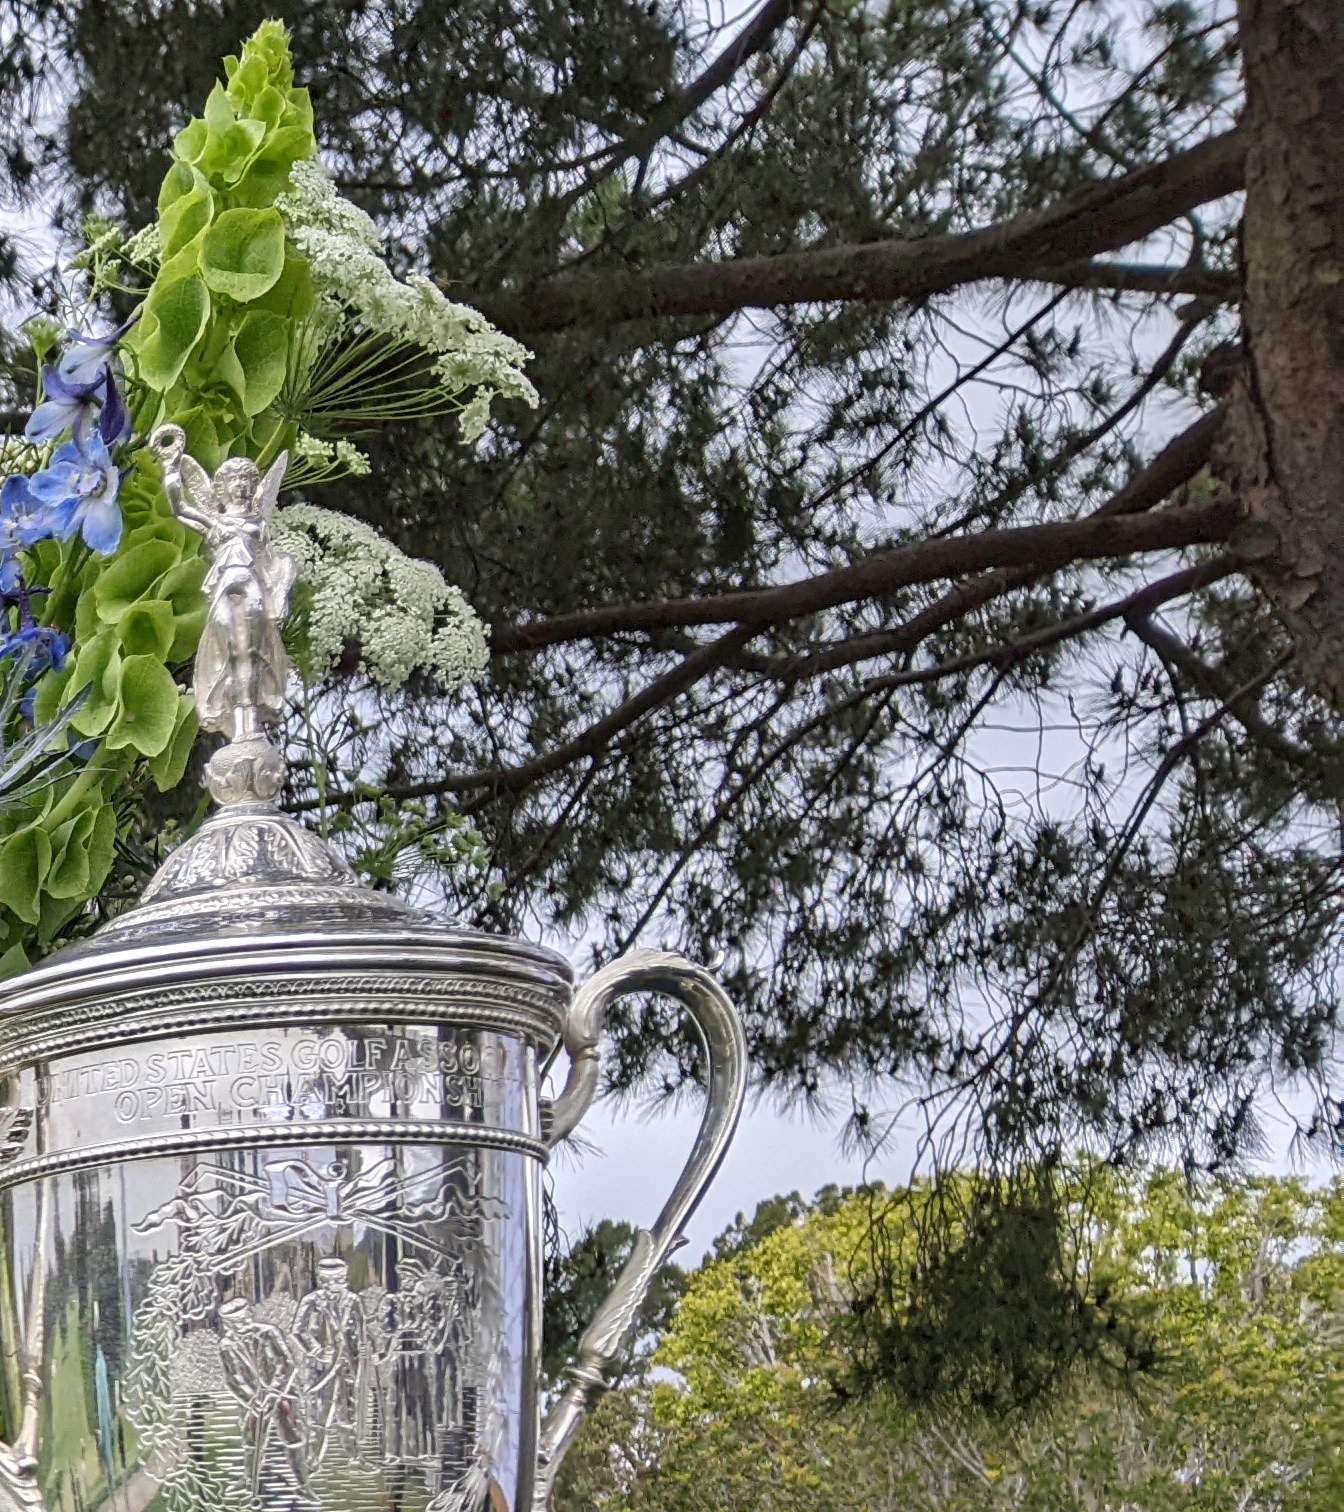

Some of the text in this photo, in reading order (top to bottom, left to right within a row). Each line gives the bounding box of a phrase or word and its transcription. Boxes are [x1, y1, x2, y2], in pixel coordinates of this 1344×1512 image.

[33, 1057, 140, 1107] UNITED
[145, 1041, 282, 1084] STATES
[291, 1037, 387, 1071] GOLF
[115, 1069, 502, 1124] OPEN CHAMPIONSH
